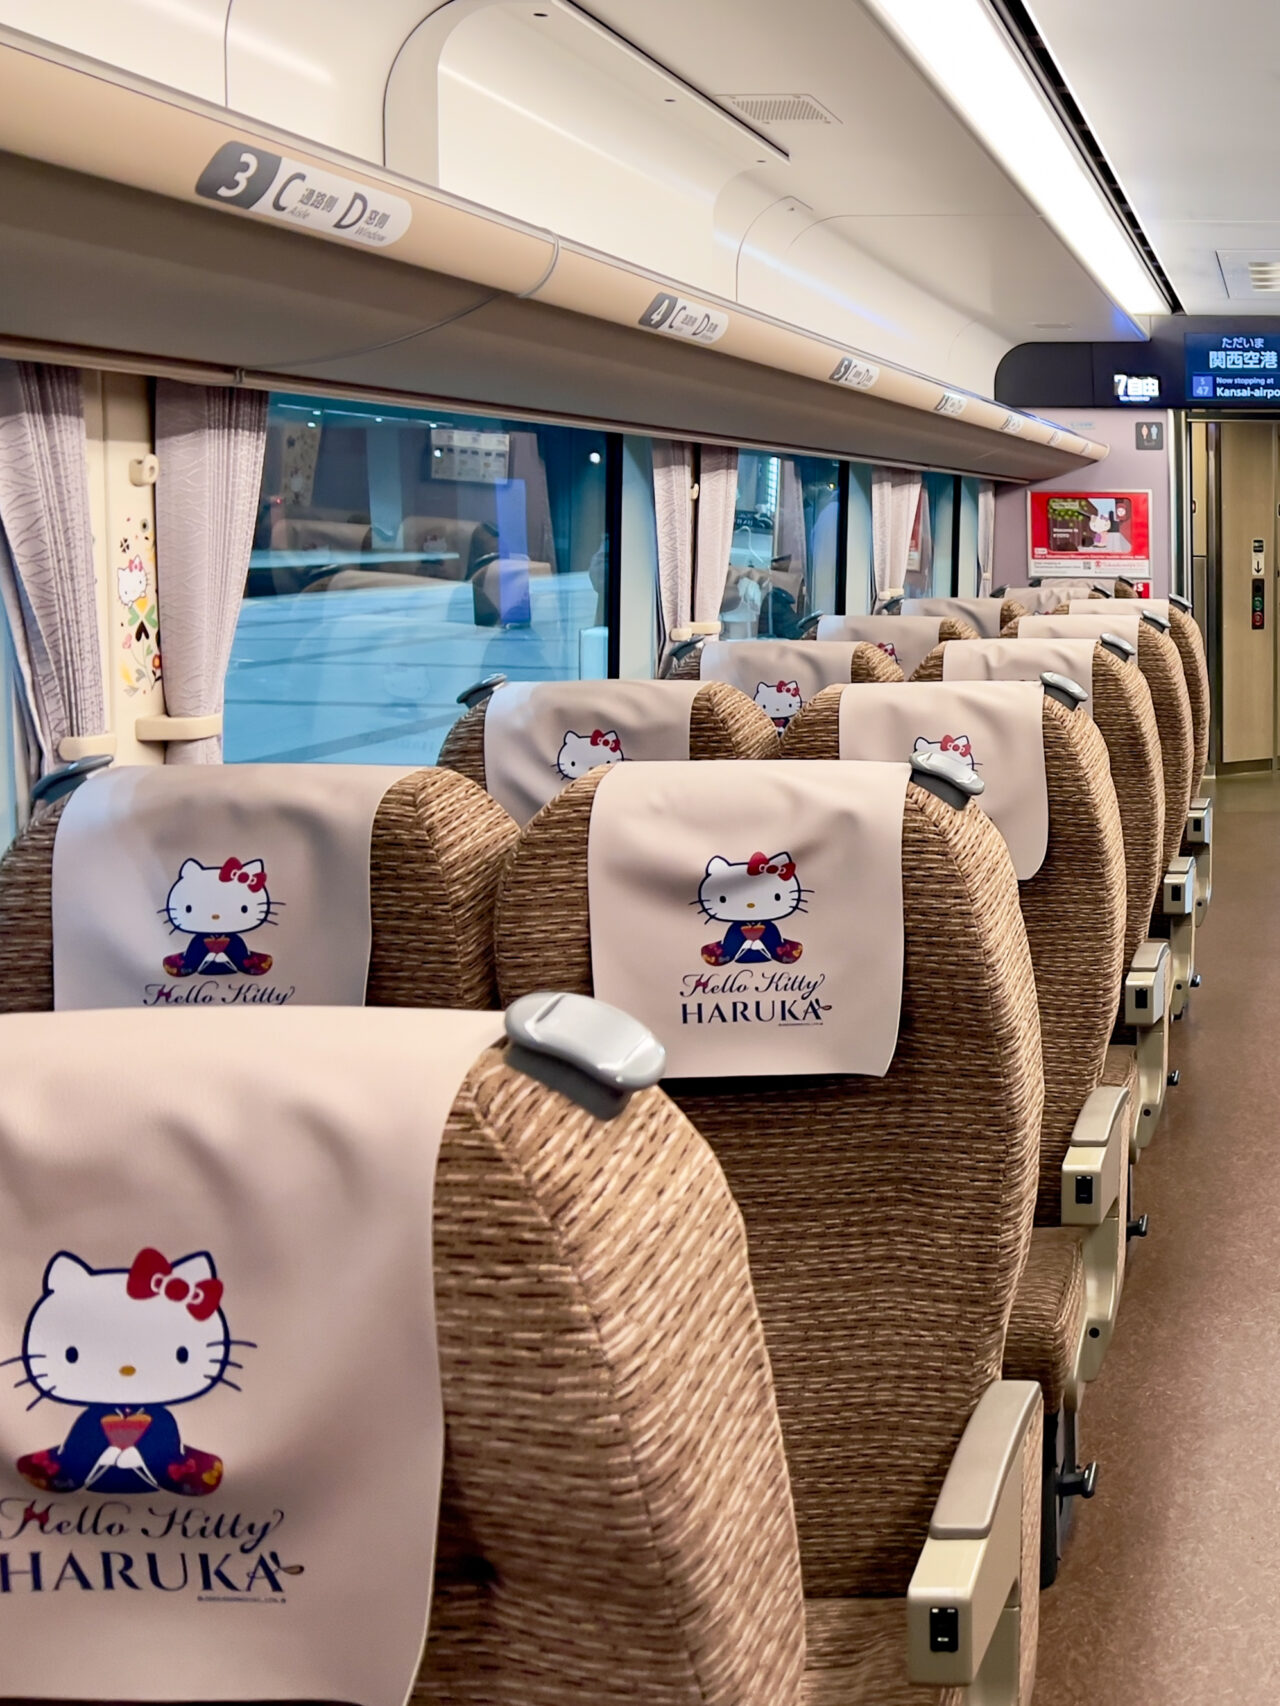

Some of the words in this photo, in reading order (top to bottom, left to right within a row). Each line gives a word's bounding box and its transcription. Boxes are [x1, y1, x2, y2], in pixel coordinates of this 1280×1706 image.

[216, 153, 258, 198] 3
[272, 172, 306, 212] C
[288, 205, 311, 221] Aisle
[298, 187, 341, 214] 通路側
[332, 191, 369, 230] D
[364, 209, 392, 230] 窓側
[354, 225, 388, 243] Window
[650, 299, 670, 325] 4
[668, 304, 687, 329] C
[691, 312, 711, 336] D
[1221, 337, 1265, 349] ただいま
[1208, 351, 1278, 369] 関西空港
[1196, 387, 1209, 396] 47
[1216, 377, 1234, 385] Now
[1234, 377, 1266, 386] stopping
[143, 981, 219, 1006] Hello
[221, 983, 296, 1006] Kitty
[680, 969, 754, 998] Hello
[755, 971, 826, 1000] Kitty
[681, 999, 823, 1025] HARUKA
[0, 1499, 132, 1541] Hello
[141, 1506, 285, 1554] Kitty
[0, 1550, 285, 1593] HARUKA
